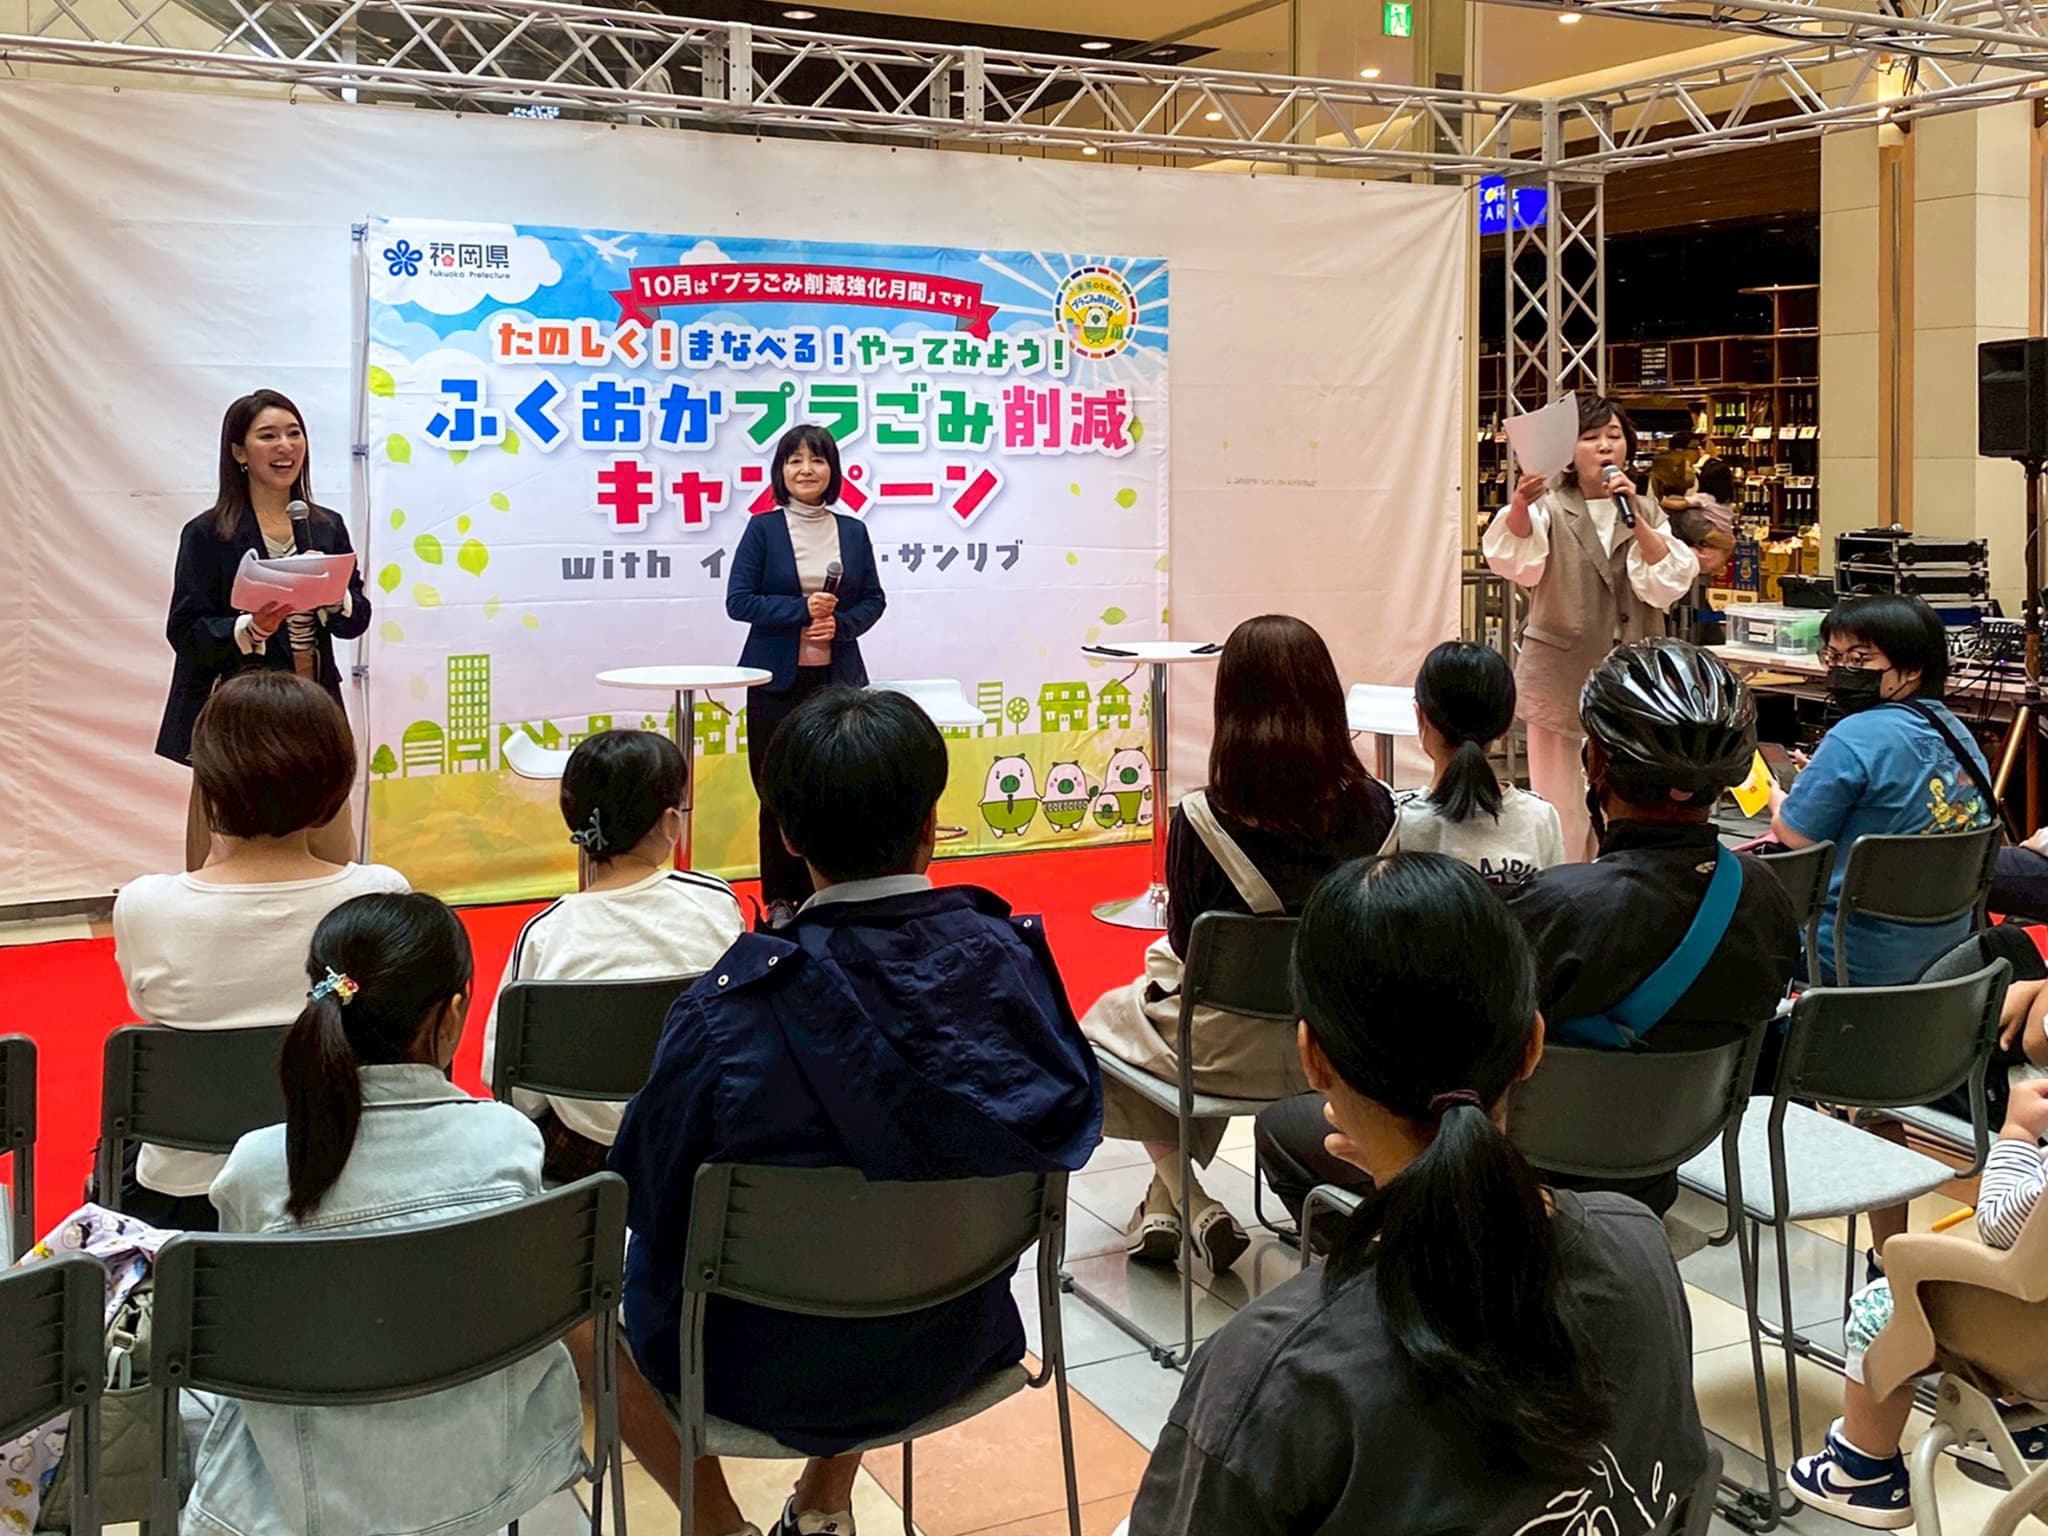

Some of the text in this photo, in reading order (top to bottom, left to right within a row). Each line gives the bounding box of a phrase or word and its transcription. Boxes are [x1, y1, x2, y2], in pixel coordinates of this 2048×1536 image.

[430, 242, 509, 269] 福岡県
[429, 270, 511, 279] Fukuoka Prefecture
[426, 379, 1128, 450] ふくおかプラごみ削減
[562, 550, 671, 580] with
